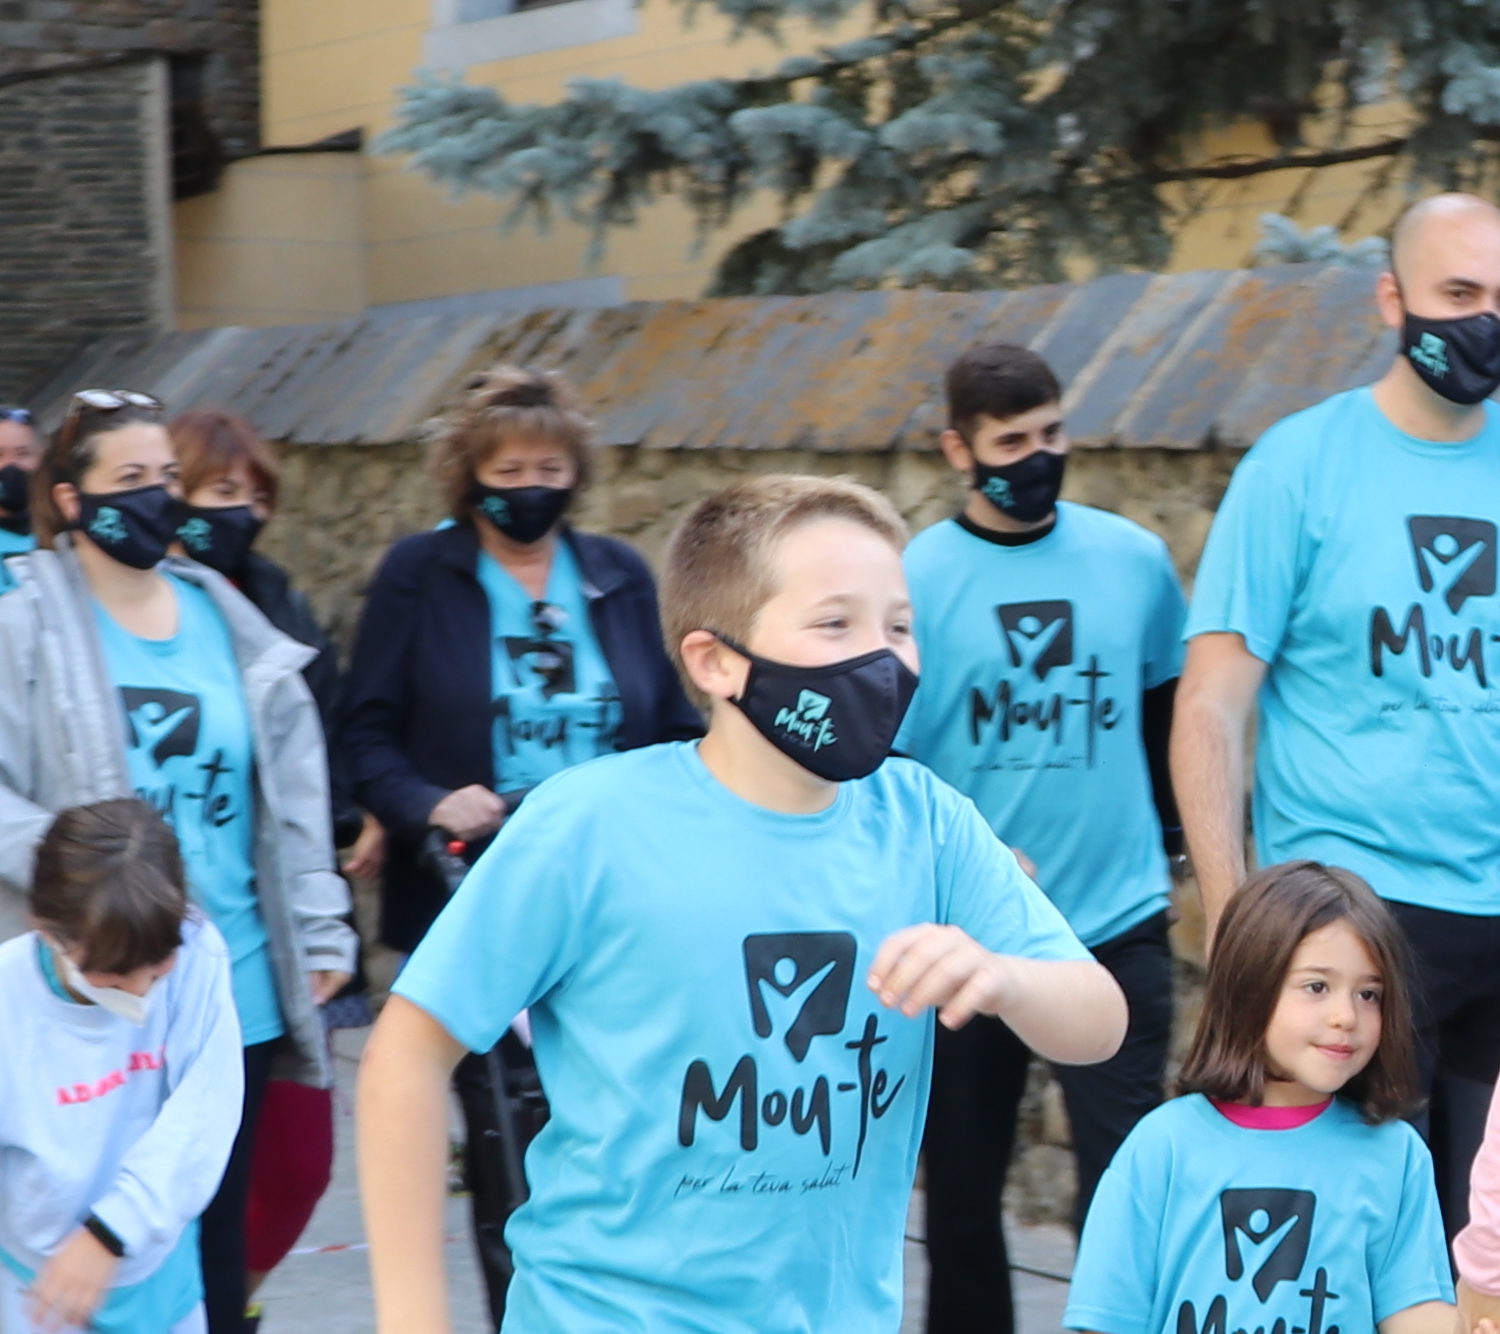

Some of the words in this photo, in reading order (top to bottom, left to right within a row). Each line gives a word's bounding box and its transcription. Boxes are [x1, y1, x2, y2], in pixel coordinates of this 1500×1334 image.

[970, 653, 1125, 770] Mou-te
[678, 1012, 906, 1180] Mou-te
[673, 1173, 714, 1198] per
[719, 1165, 746, 1193] la
[751, 1170, 794, 1193] teva
[800, 1160, 852, 1195] salut
